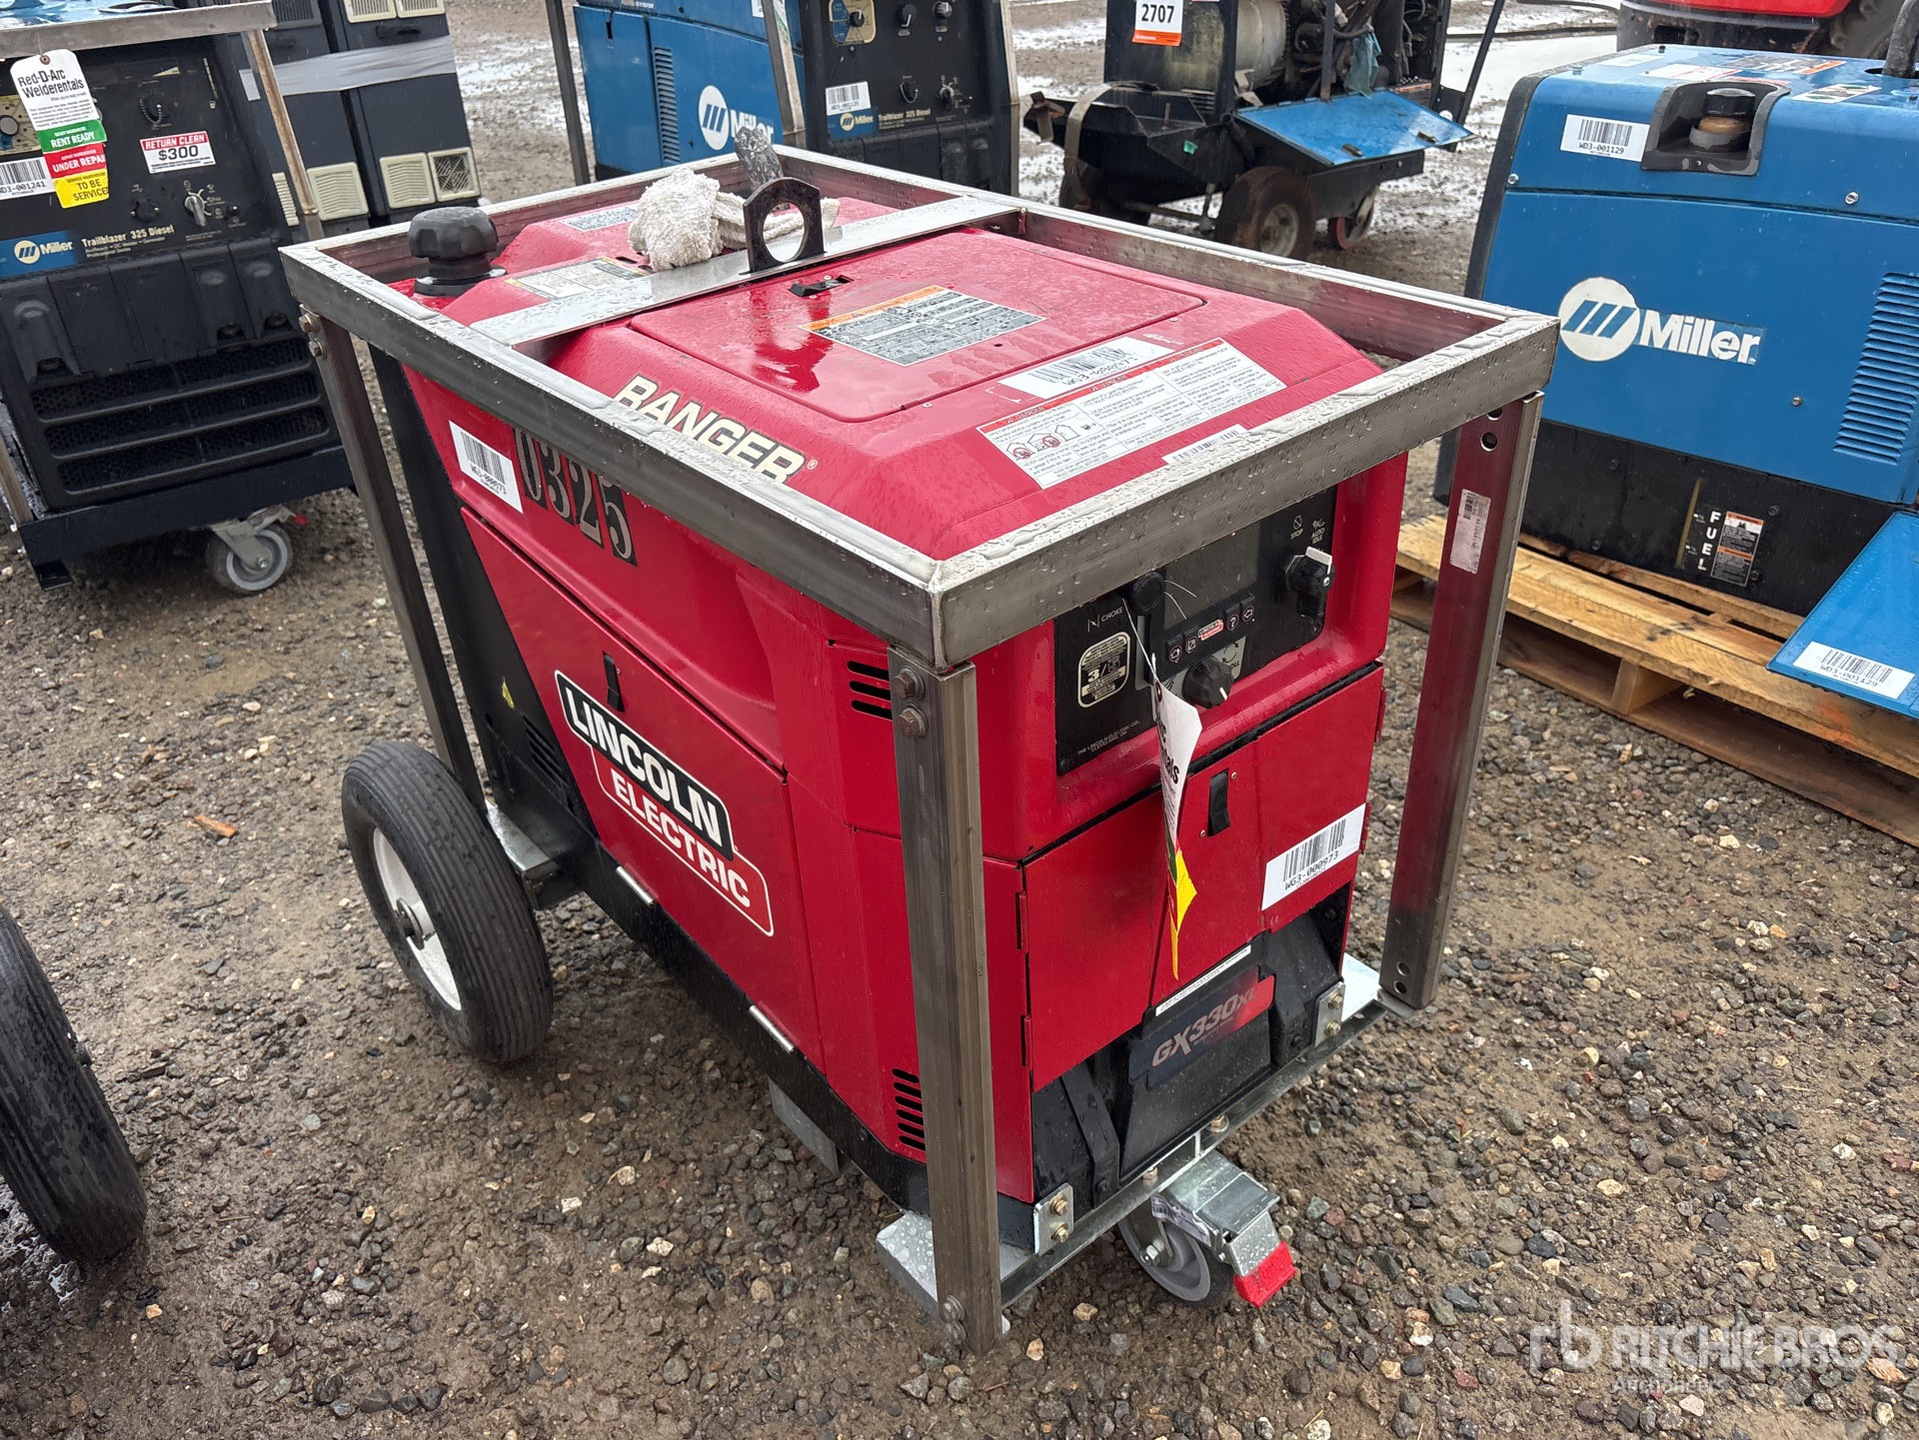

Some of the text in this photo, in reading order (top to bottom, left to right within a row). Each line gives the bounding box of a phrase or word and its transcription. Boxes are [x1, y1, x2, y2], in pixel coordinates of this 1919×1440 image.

[1141, 3, 1175, 24] 2707
[22, 78, 85, 99] Welderentals
[50, 131, 95, 148] RENT READY
[145, 133, 205, 150] RETURN CLEAN
[1578, 142, 1625, 155] WD3-001129
[158, 145, 199, 161] $300
[52, 159, 80, 173] UNDER
[76, 178, 102, 191] TO BE
[81, 233, 127, 248] Trailblazer
[130, 228, 147, 240] 325
[148, 223, 175, 237] Diesel
[39, 240, 73, 256] Miller
[1639, 309, 1761, 364] Miller
[612, 373, 807, 485] RANGER
[1101, 606, 1124, 623] CHOKE
[565, 686, 723, 847] LINCOLN
[611, 767, 751, 908] ELECTRIC
[1284, 850, 1339, 891] WG3-000973
